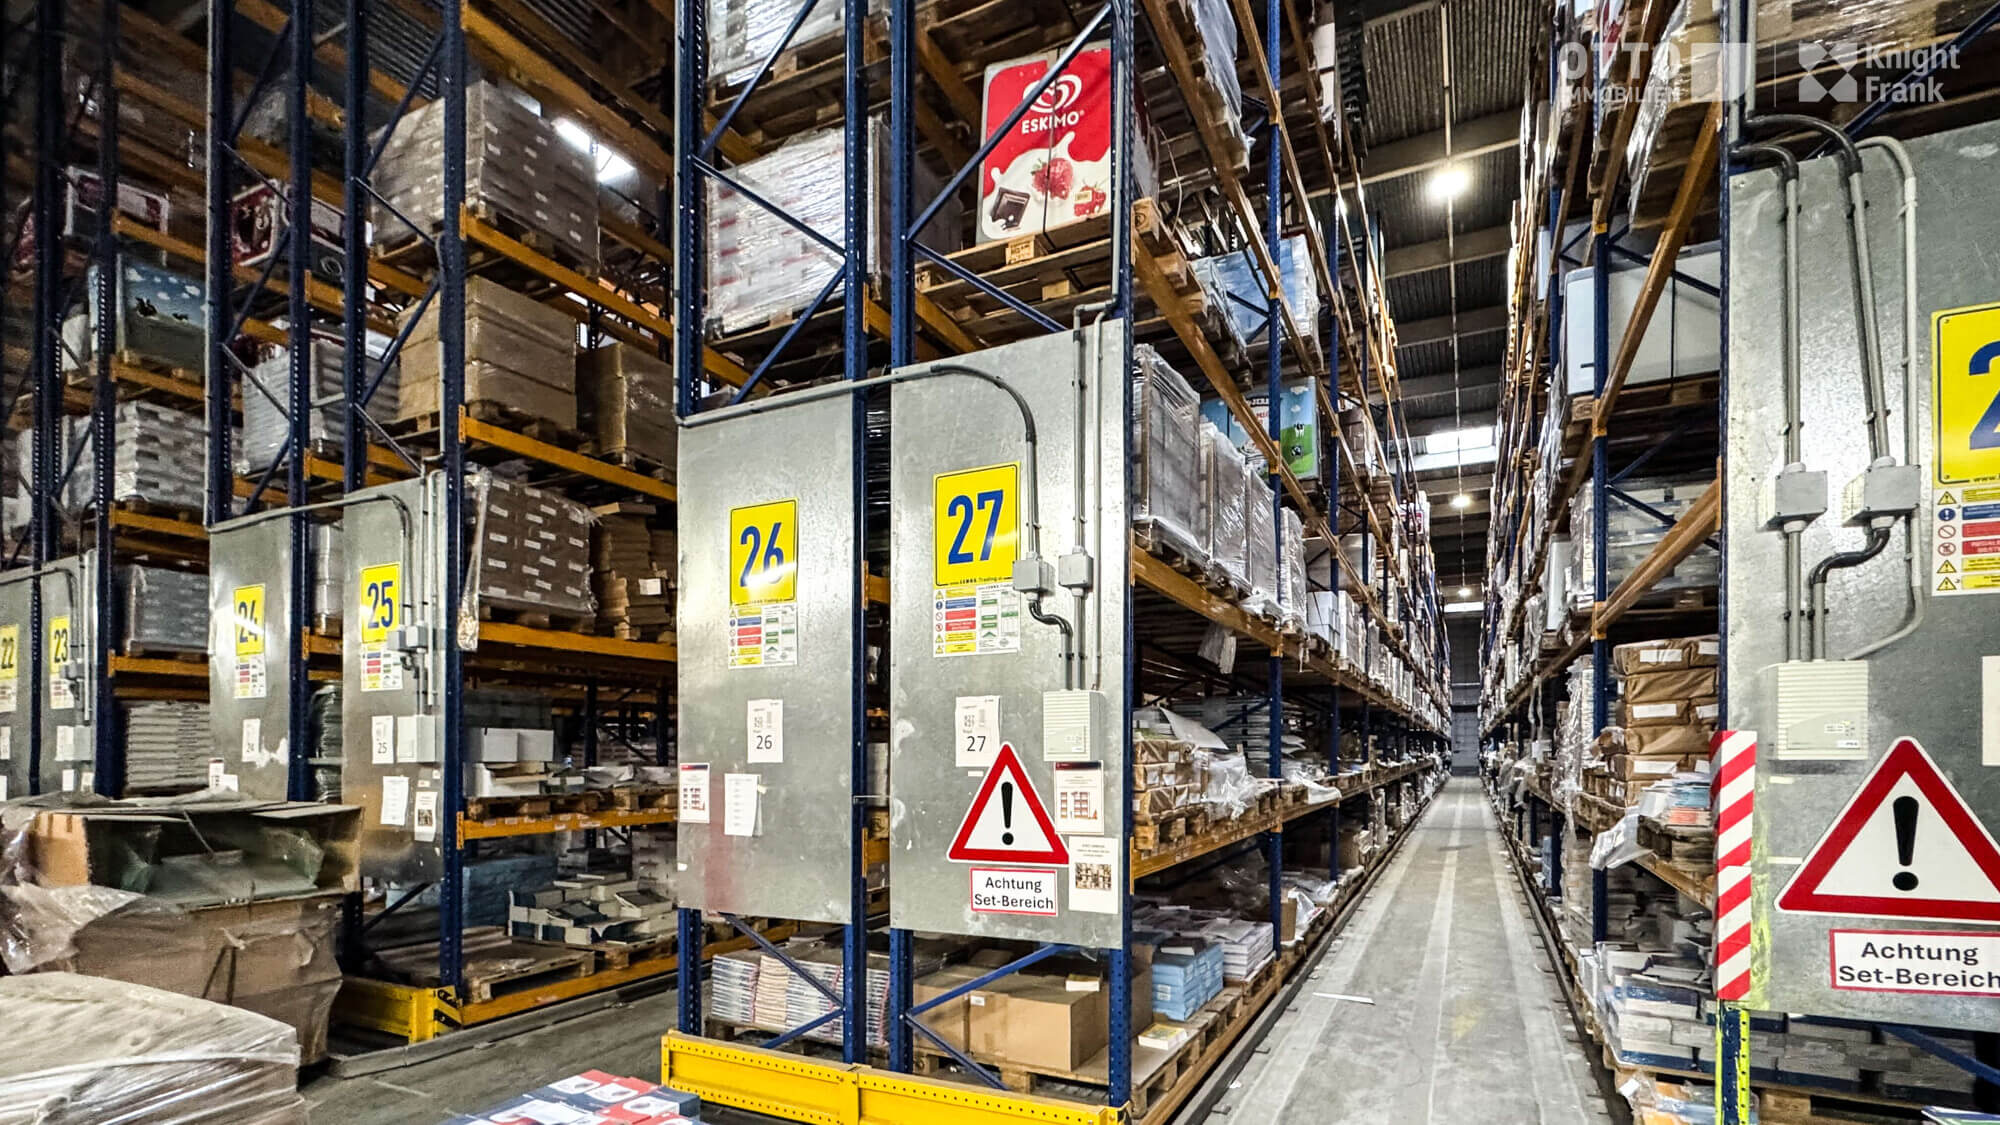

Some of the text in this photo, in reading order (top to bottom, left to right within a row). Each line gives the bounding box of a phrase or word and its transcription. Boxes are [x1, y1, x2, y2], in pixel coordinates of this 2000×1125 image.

[947, 489, 1004, 565] 27
[739, 521, 784, 588] 26
[367, 580, 393, 629] 25
[238, 599, 258, 643] 24
[1, 637, 14, 670] 22
[54, 629, 69, 664] 23
[377, 742, 388, 754] 25
[755, 734, 773, 750] 26
[966, 735, 986, 752] 27
[985, 876, 1042, 893] Achtung
[974, 893, 1054, 910] Set-Bereich
[1860, 940, 1979, 966] Achtung
[1838, 964, 2000, 989] Set-Bereich
